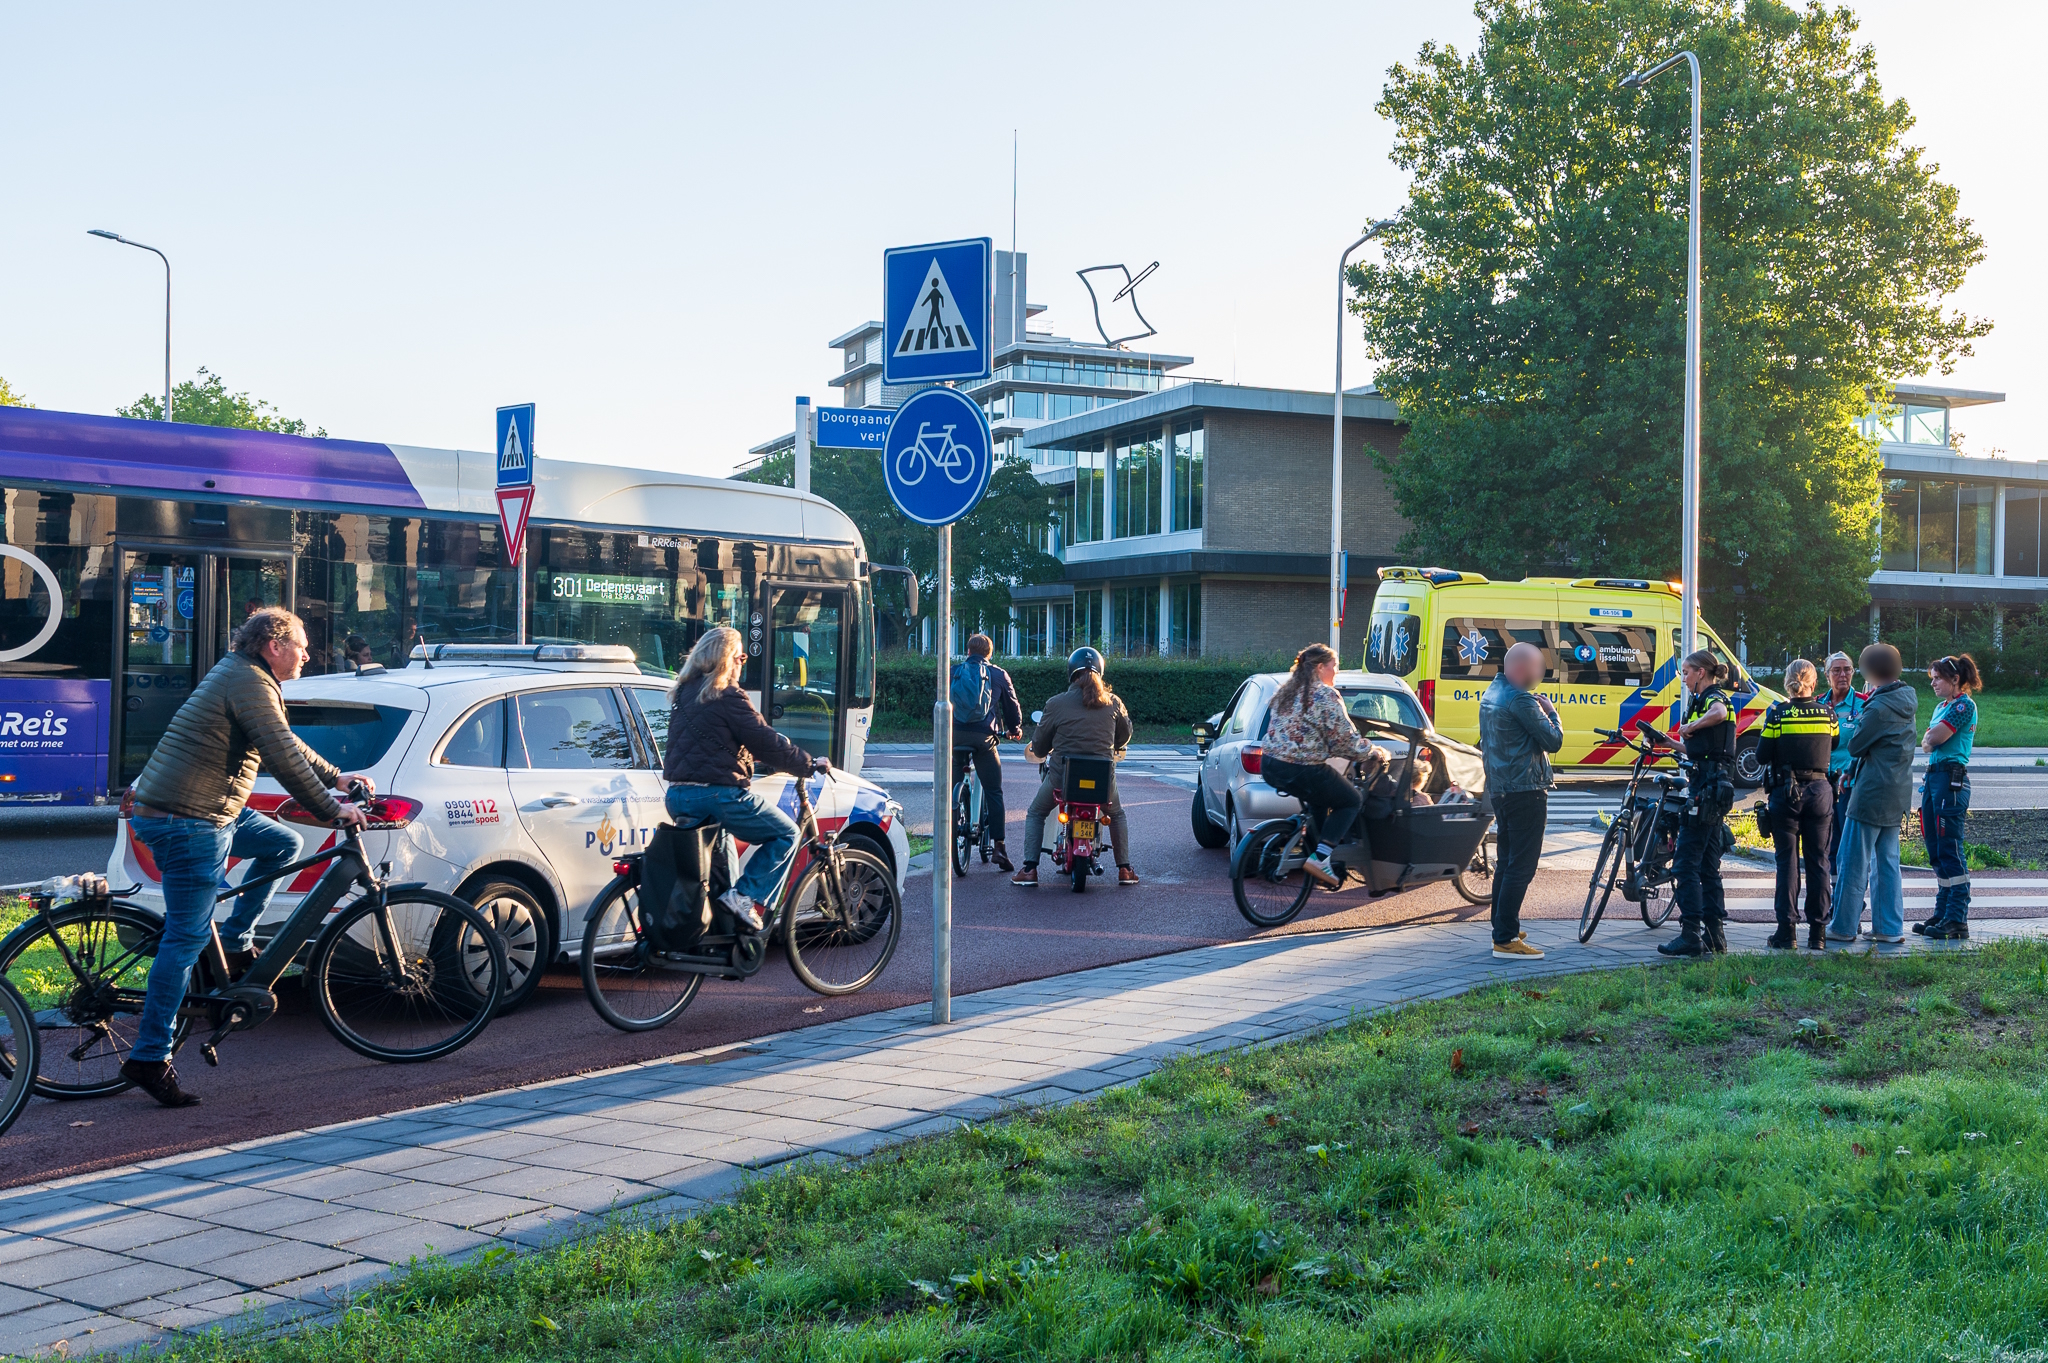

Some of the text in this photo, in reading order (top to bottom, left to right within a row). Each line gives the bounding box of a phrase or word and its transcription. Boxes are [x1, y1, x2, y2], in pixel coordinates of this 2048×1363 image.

[821, 411, 891, 426] Doorgaand
[651, 537, 693, 549] RRReis.nl
[553, 577, 665, 598] 301 Dedemsvaart
[1599, 645, 1640, 655] ambulance
[1599, 653, 1635, 662] ijsselland
[1453, 689, 1607, 705] 04-1 ULANCE
[0, 709, 69, 736] Reis
[20, 740, 39, 748] ons
[41, 740, 64, 748] mee
[445, 800, 471, 809] 0900
[472, 799, 498, 814] 112
[447, 809, 473, 819] 8844
[475, 814, 500, 825] spoed
[585, 827, 656, 856] POLIT
